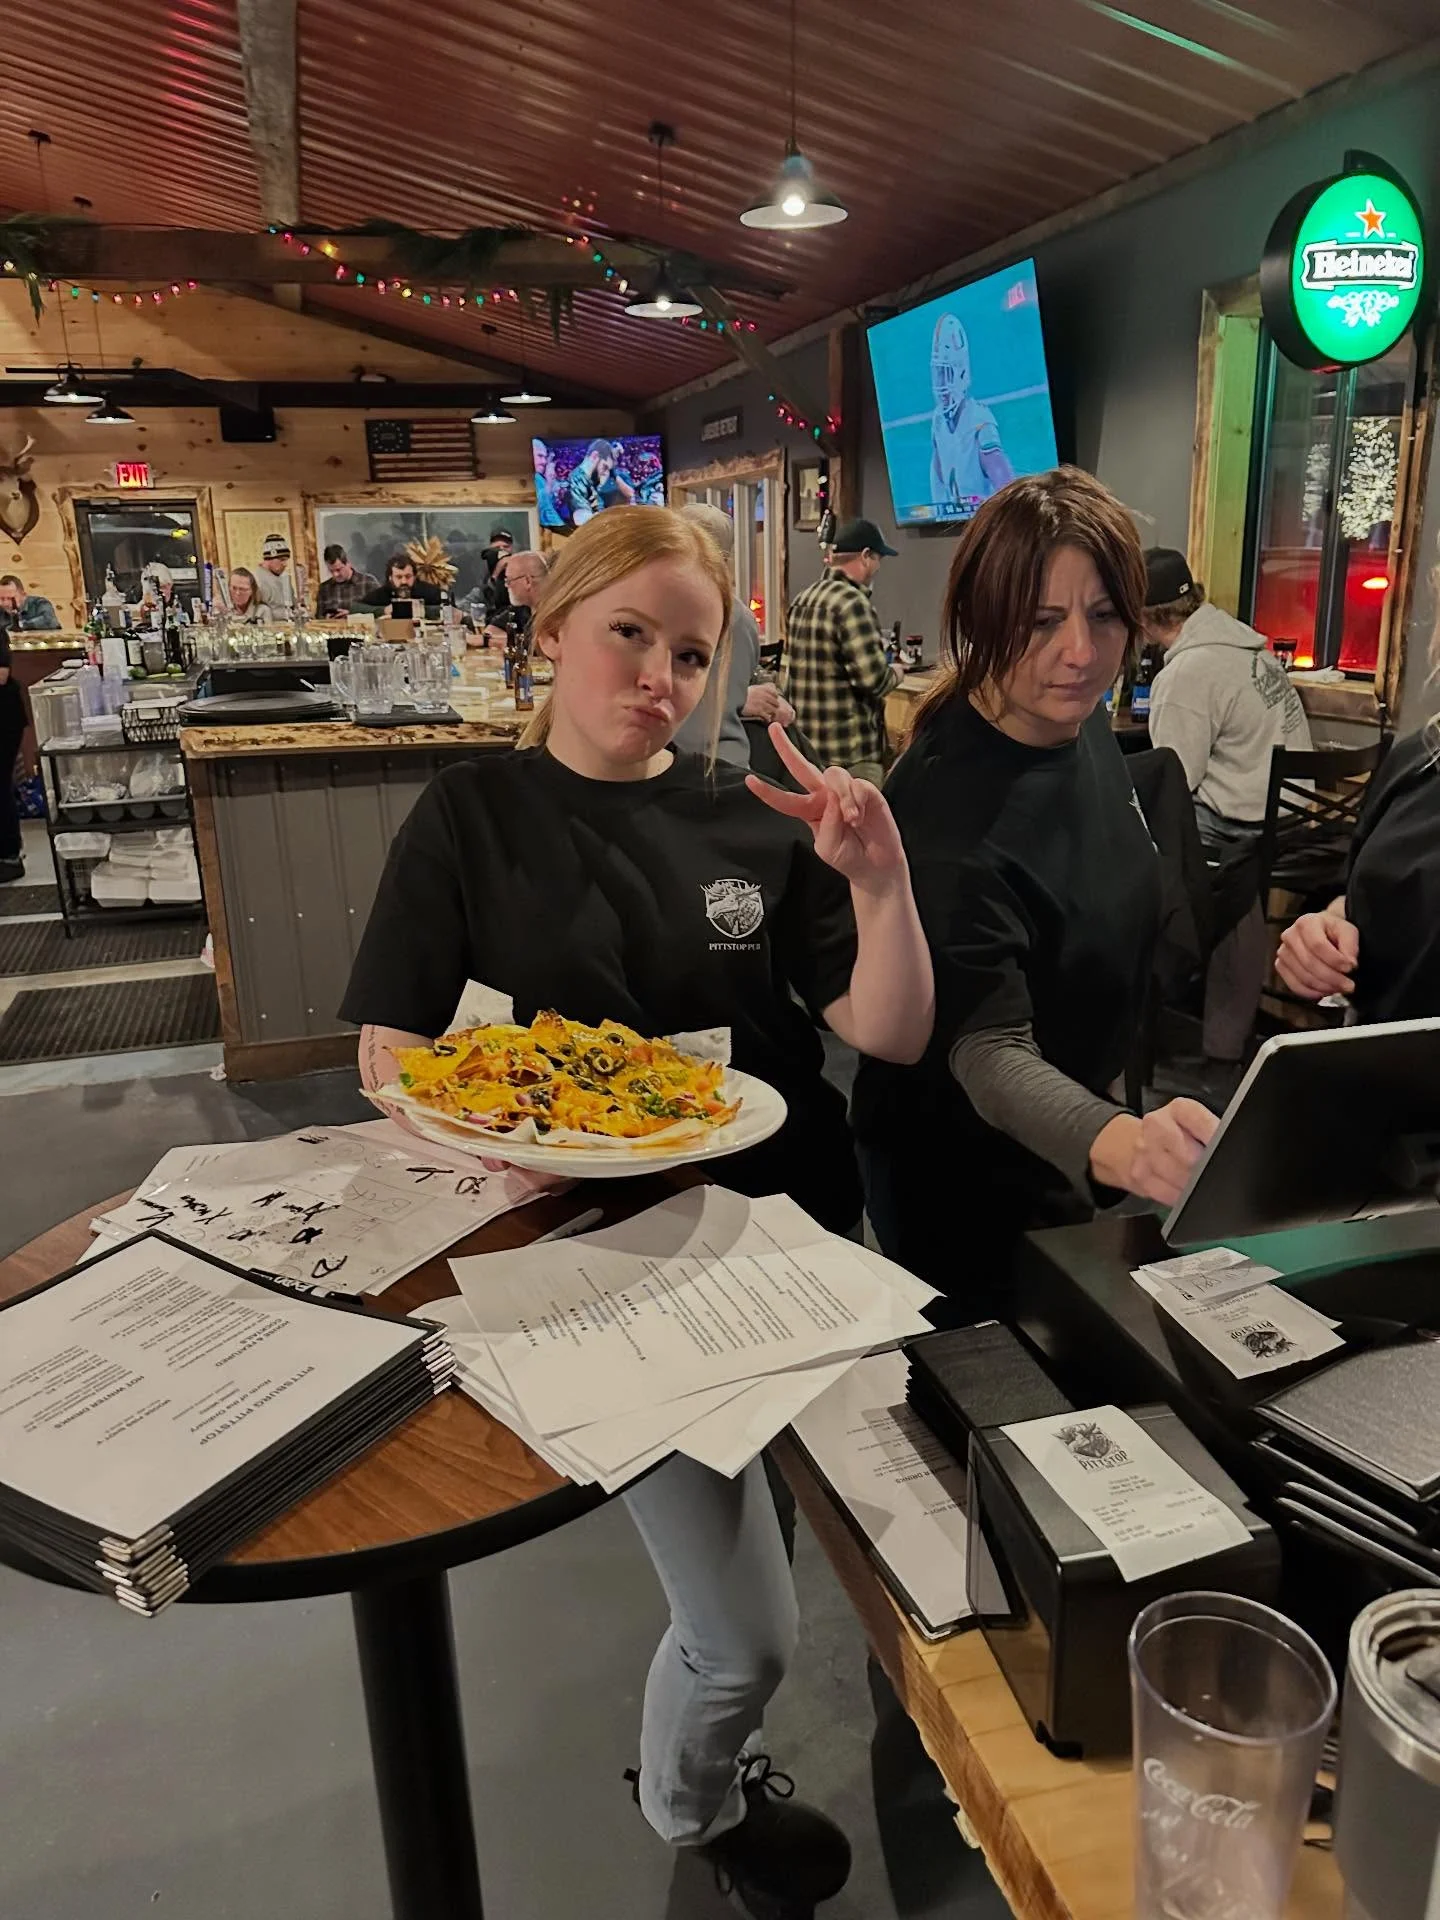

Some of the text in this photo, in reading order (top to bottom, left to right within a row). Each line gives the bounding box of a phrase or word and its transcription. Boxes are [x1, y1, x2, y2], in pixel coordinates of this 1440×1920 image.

[116, 463, 148, 488] EXIT
[708, 943, 747, 951] PITTSTOP
[253, 1366, 315, 1408] PITTSBURG
[200, 1407, 254, 1445] PITTSTOP
[1079, 1450, 1128, 1470] PITTSTOP
